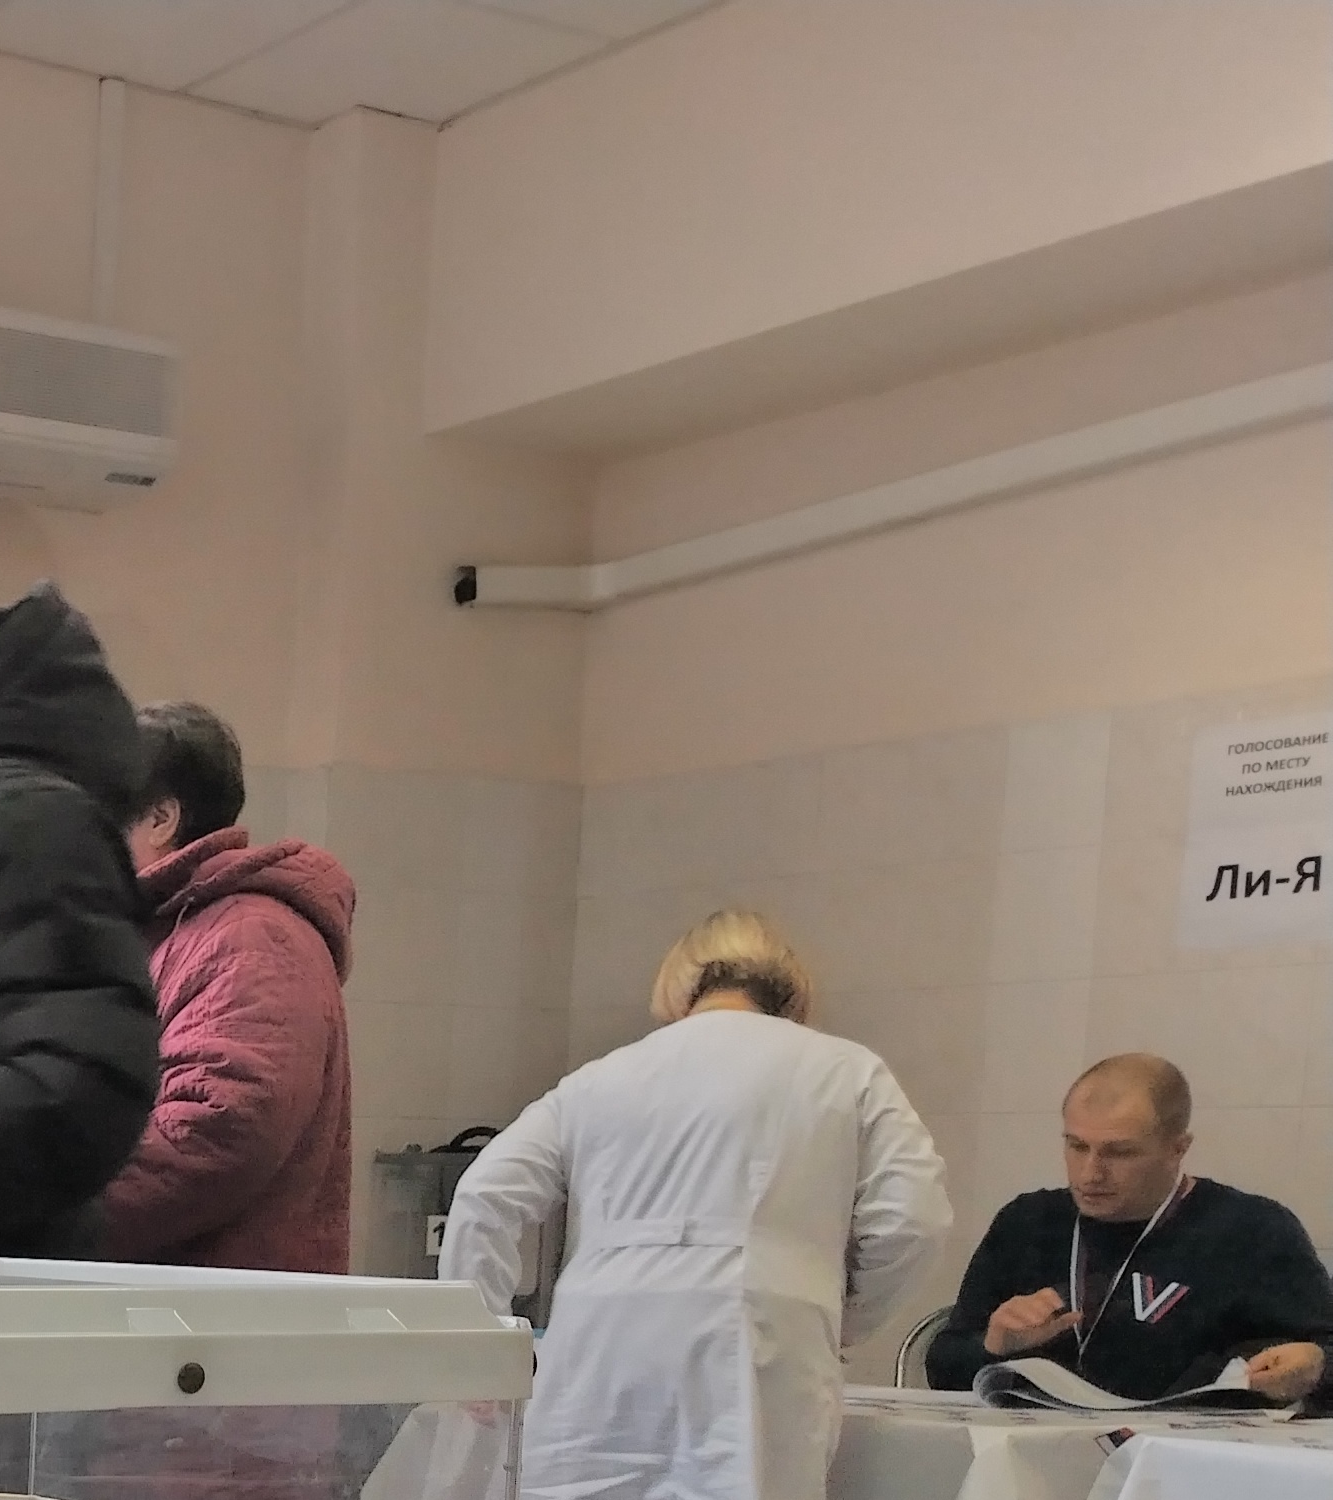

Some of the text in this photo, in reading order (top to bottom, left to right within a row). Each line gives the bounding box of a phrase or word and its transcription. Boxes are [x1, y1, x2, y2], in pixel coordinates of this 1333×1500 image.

[1227, 732, 1330, 756] ГОЛОСОВАНИЕ
[1241, 756, 1312, 775] ПО МЕСТУ
[1225, 775, 1323, 797] НАХОЖДЕНИЯ
[1206, 855, 1323, 902] Ли-Я
